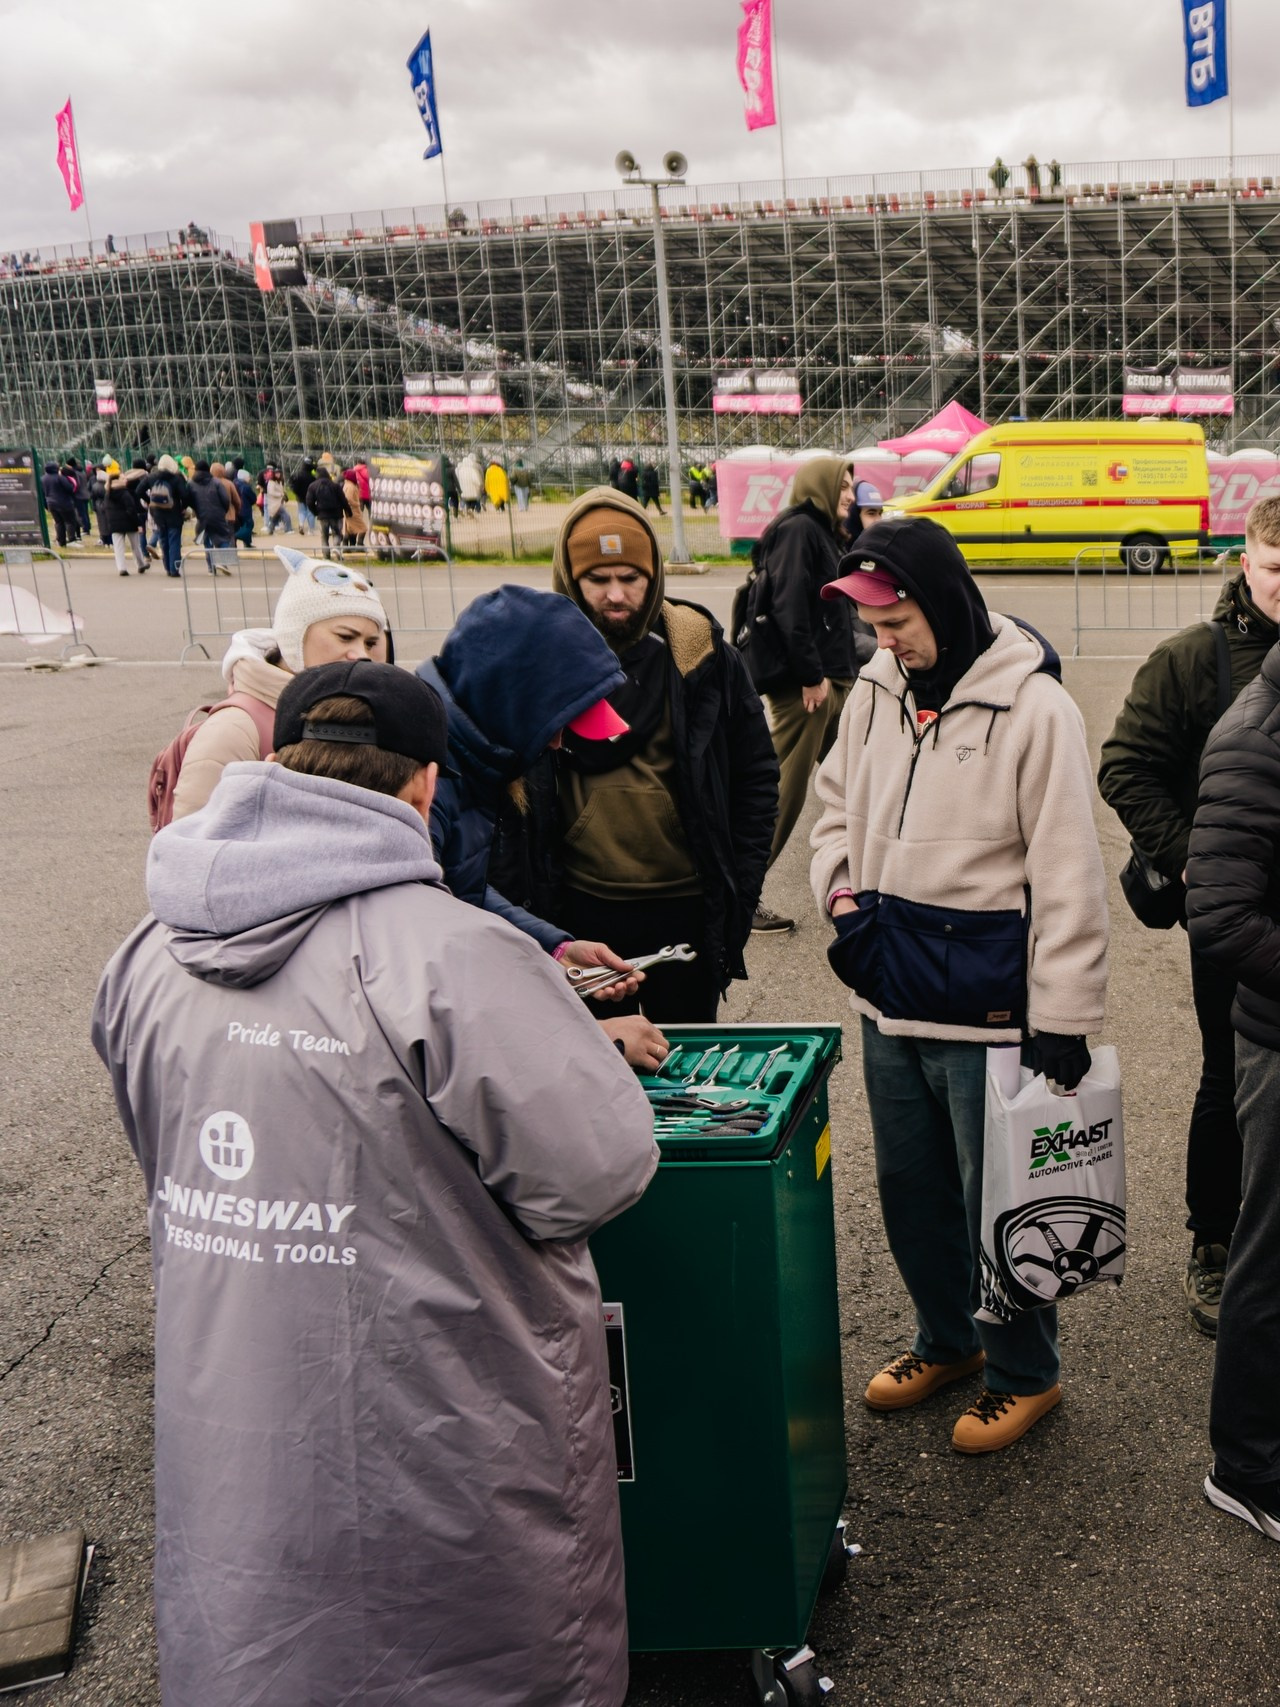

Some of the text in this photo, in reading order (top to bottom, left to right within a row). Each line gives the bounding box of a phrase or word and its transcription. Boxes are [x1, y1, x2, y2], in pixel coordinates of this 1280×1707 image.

[1189, 1, 1214, 86] ВТБ
[255, 242, 269, 270] 4
[1127, 375, 1172, 387] СЕКТОР 5
[1179, 375, 1230, 386] ОПТИМУМ
[228, 1022, 351, 1056] Pride Team
[1028, 1160, 1083, 1180] AUTOMOTIVE
[157, 1176, 356, 1233] JNNESWAY
[274, 1244, 357, 1266] TOOLS
